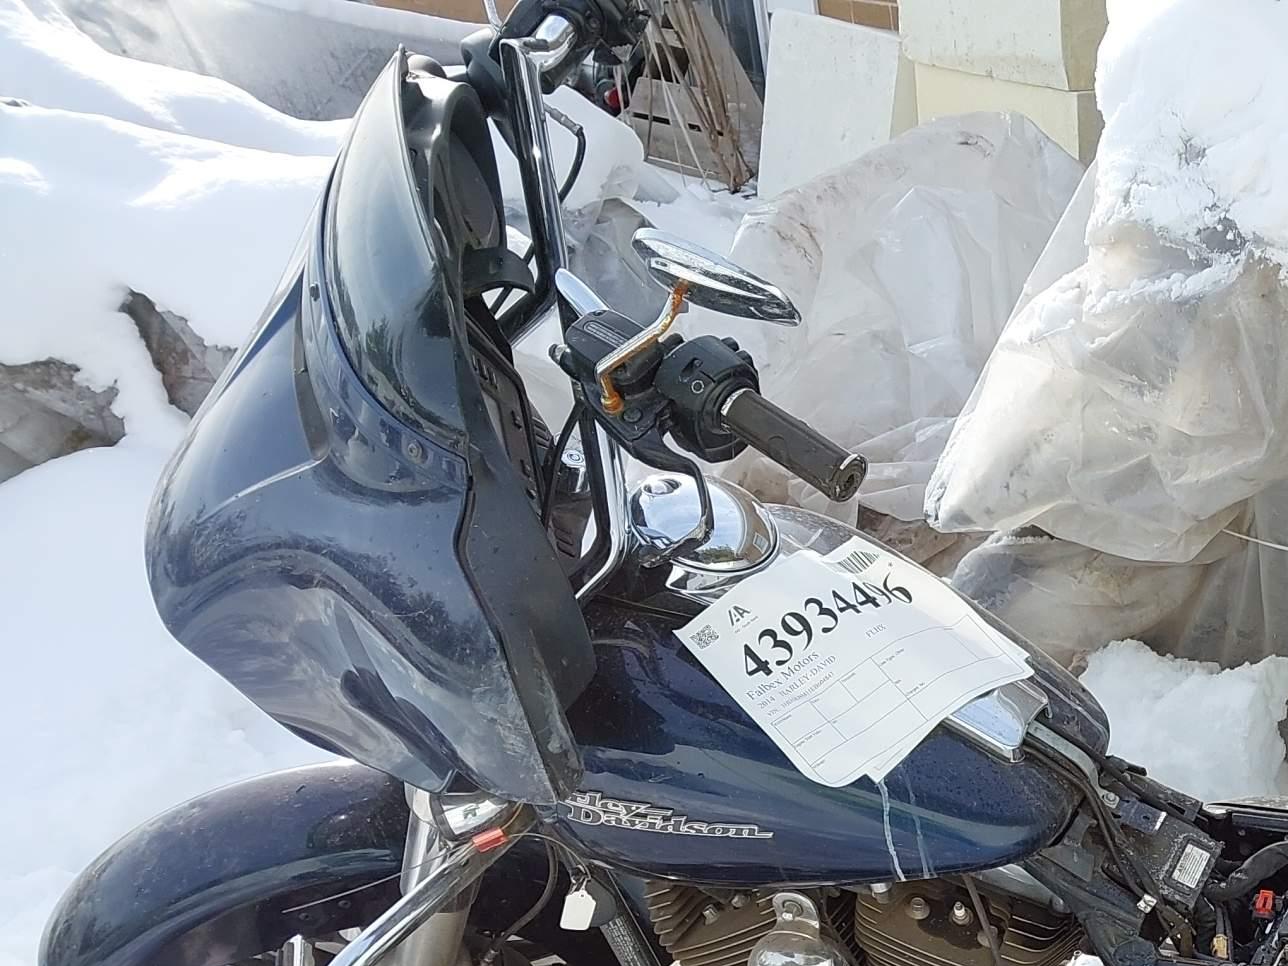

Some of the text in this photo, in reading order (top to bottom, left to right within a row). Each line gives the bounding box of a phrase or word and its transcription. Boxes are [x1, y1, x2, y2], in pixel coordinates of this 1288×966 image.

[743, 572, 913, 677] 43934496
[746, 676, 784, 701] Falbex
[783, 651, 820, 682] Motors
[758, 696, 777, 710] 2014
[779, 655, 837, 698] HARLEY-DAVID
[566, 790, 673, 818] rley
[567, 802, 774, 839] Davidson
